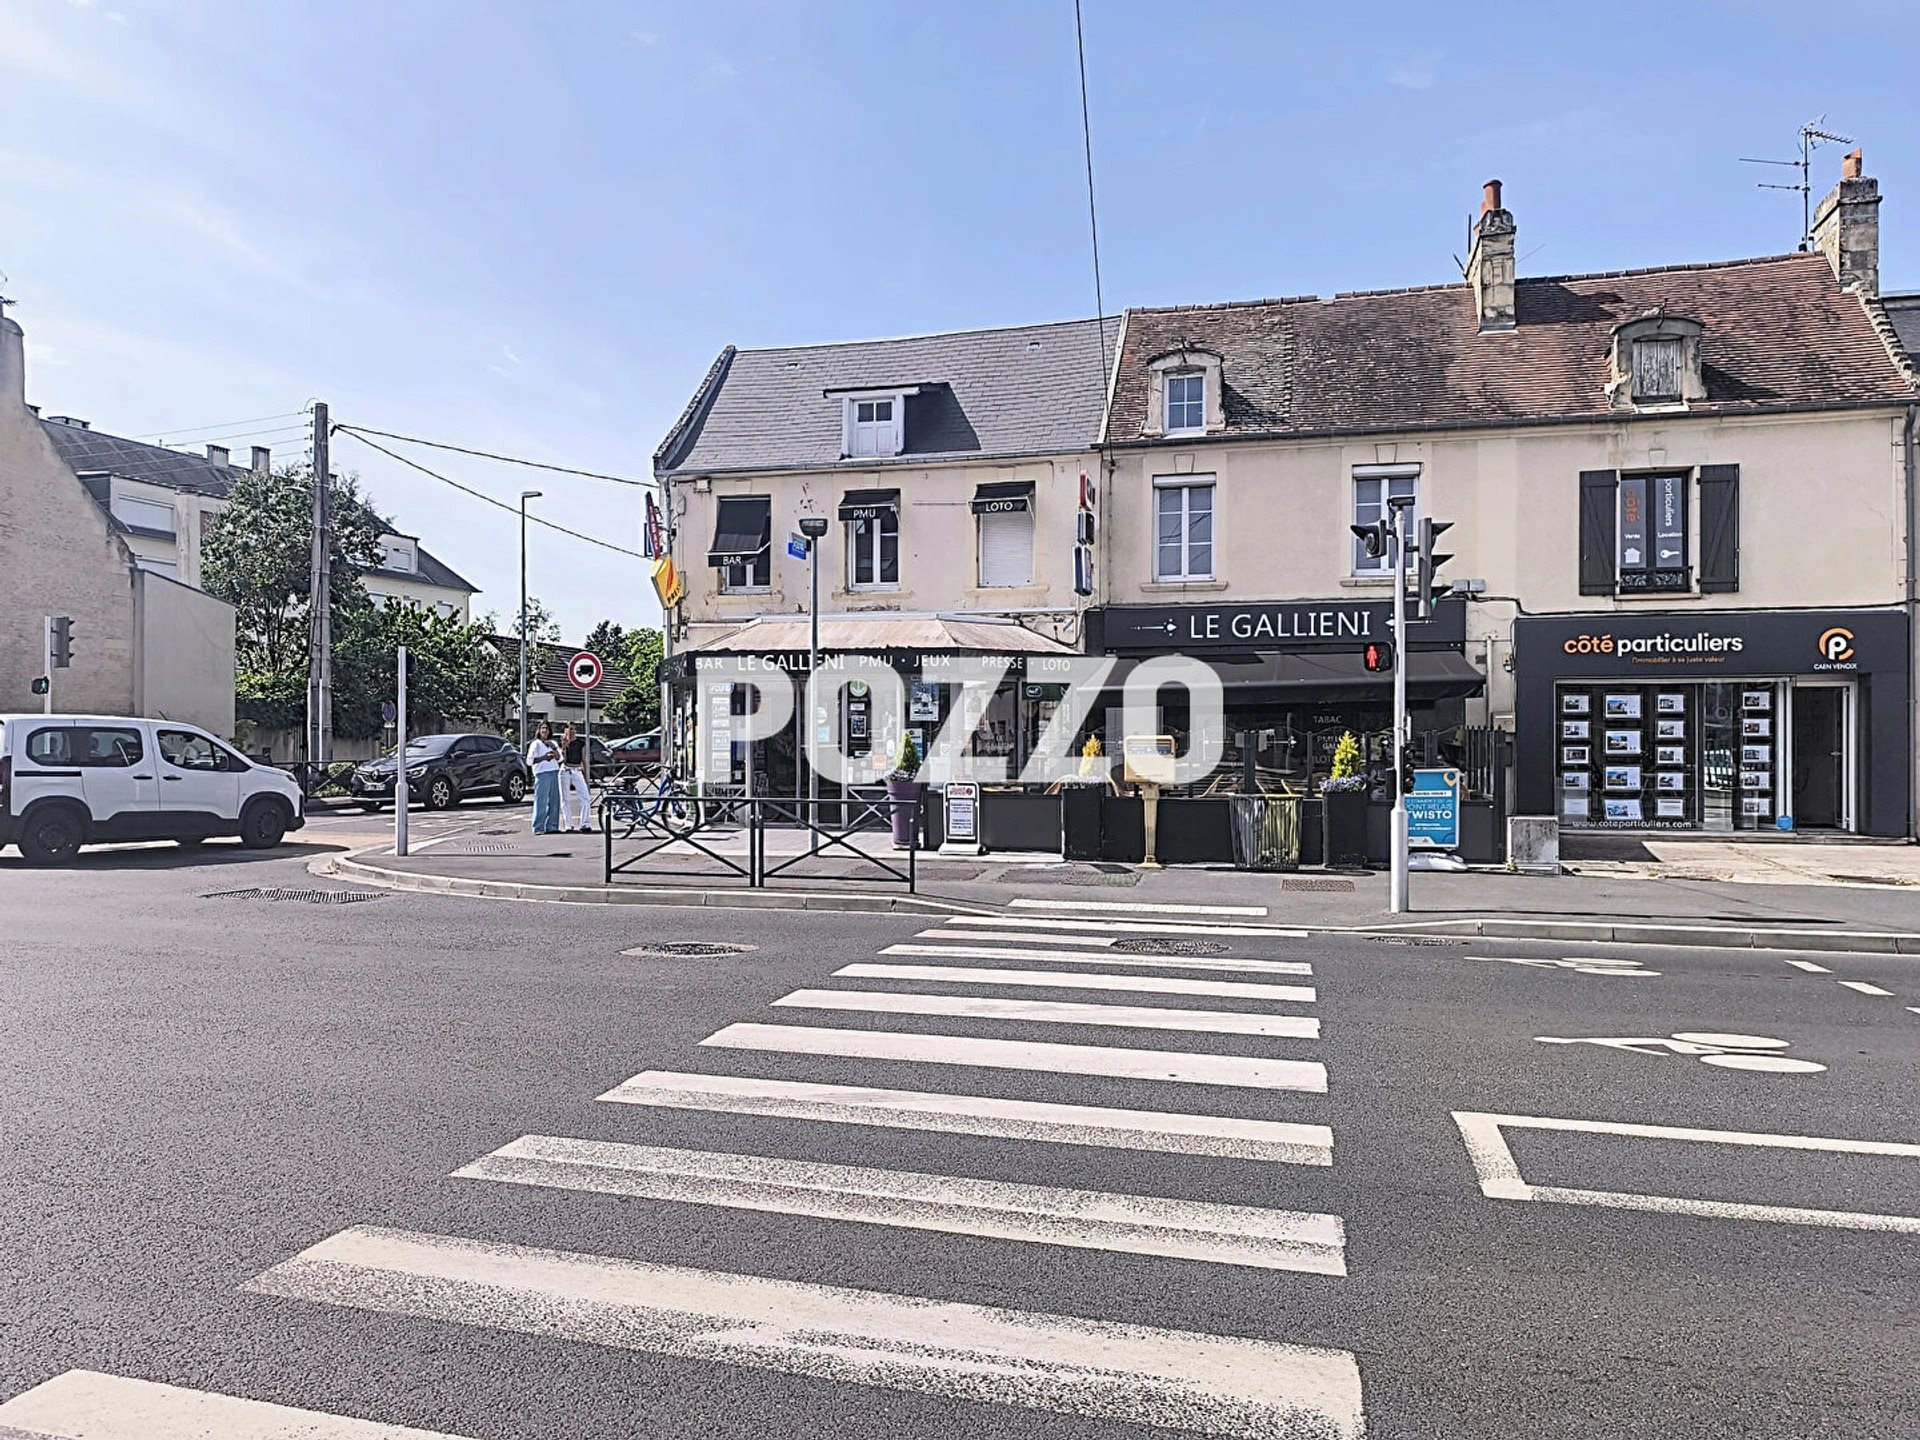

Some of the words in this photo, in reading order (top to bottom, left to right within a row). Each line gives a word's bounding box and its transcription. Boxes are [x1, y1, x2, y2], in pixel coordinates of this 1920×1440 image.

[985, 502, 1013, 512] LOTO
[853, 509, 876, 519] PMU
[723, 556, 742, 565] BAR
[1190, 615, 1220, 639] LE
[1231, 611, 1371, 638] GALLIENI
[1563, 634, 1614, 654] côté
[1617, 633, 1743, 657] particuliers
[695, 658, 724, 669] BAR
[737, 655, 756, 671] LE
[859, 656, 893, 667] PMU
[913, 655, 950, 667] JEUX
[982, 656, 1023, 669] PRESSE
[1042, 659, 1070, 671] LOTO
[1312, 715, 1342, 724] TABAC
[1408, 811, 1452, 819] WISTO
